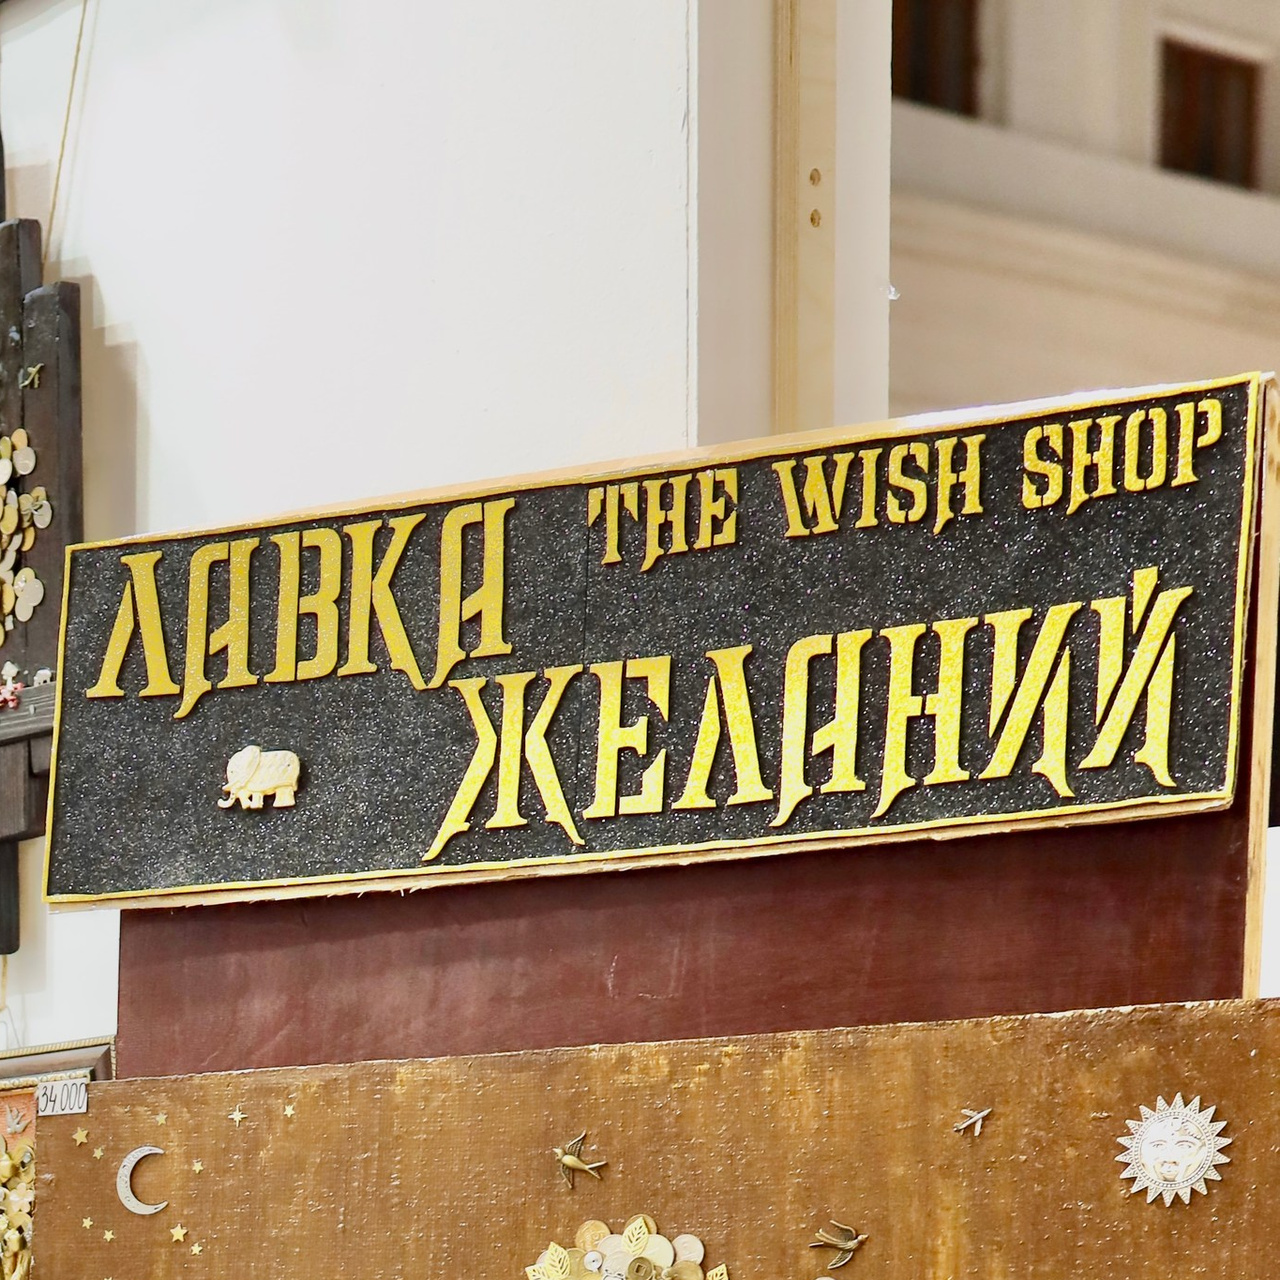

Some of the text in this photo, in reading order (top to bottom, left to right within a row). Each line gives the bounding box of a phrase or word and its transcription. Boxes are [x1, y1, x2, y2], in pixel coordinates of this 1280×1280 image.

[587, 398, 1224, 572] THE WISH SHOP
[86, 497, 517, 719] ЛАВКА
[423, 566, 1195, 861] ЖЕЛАНИЙ
